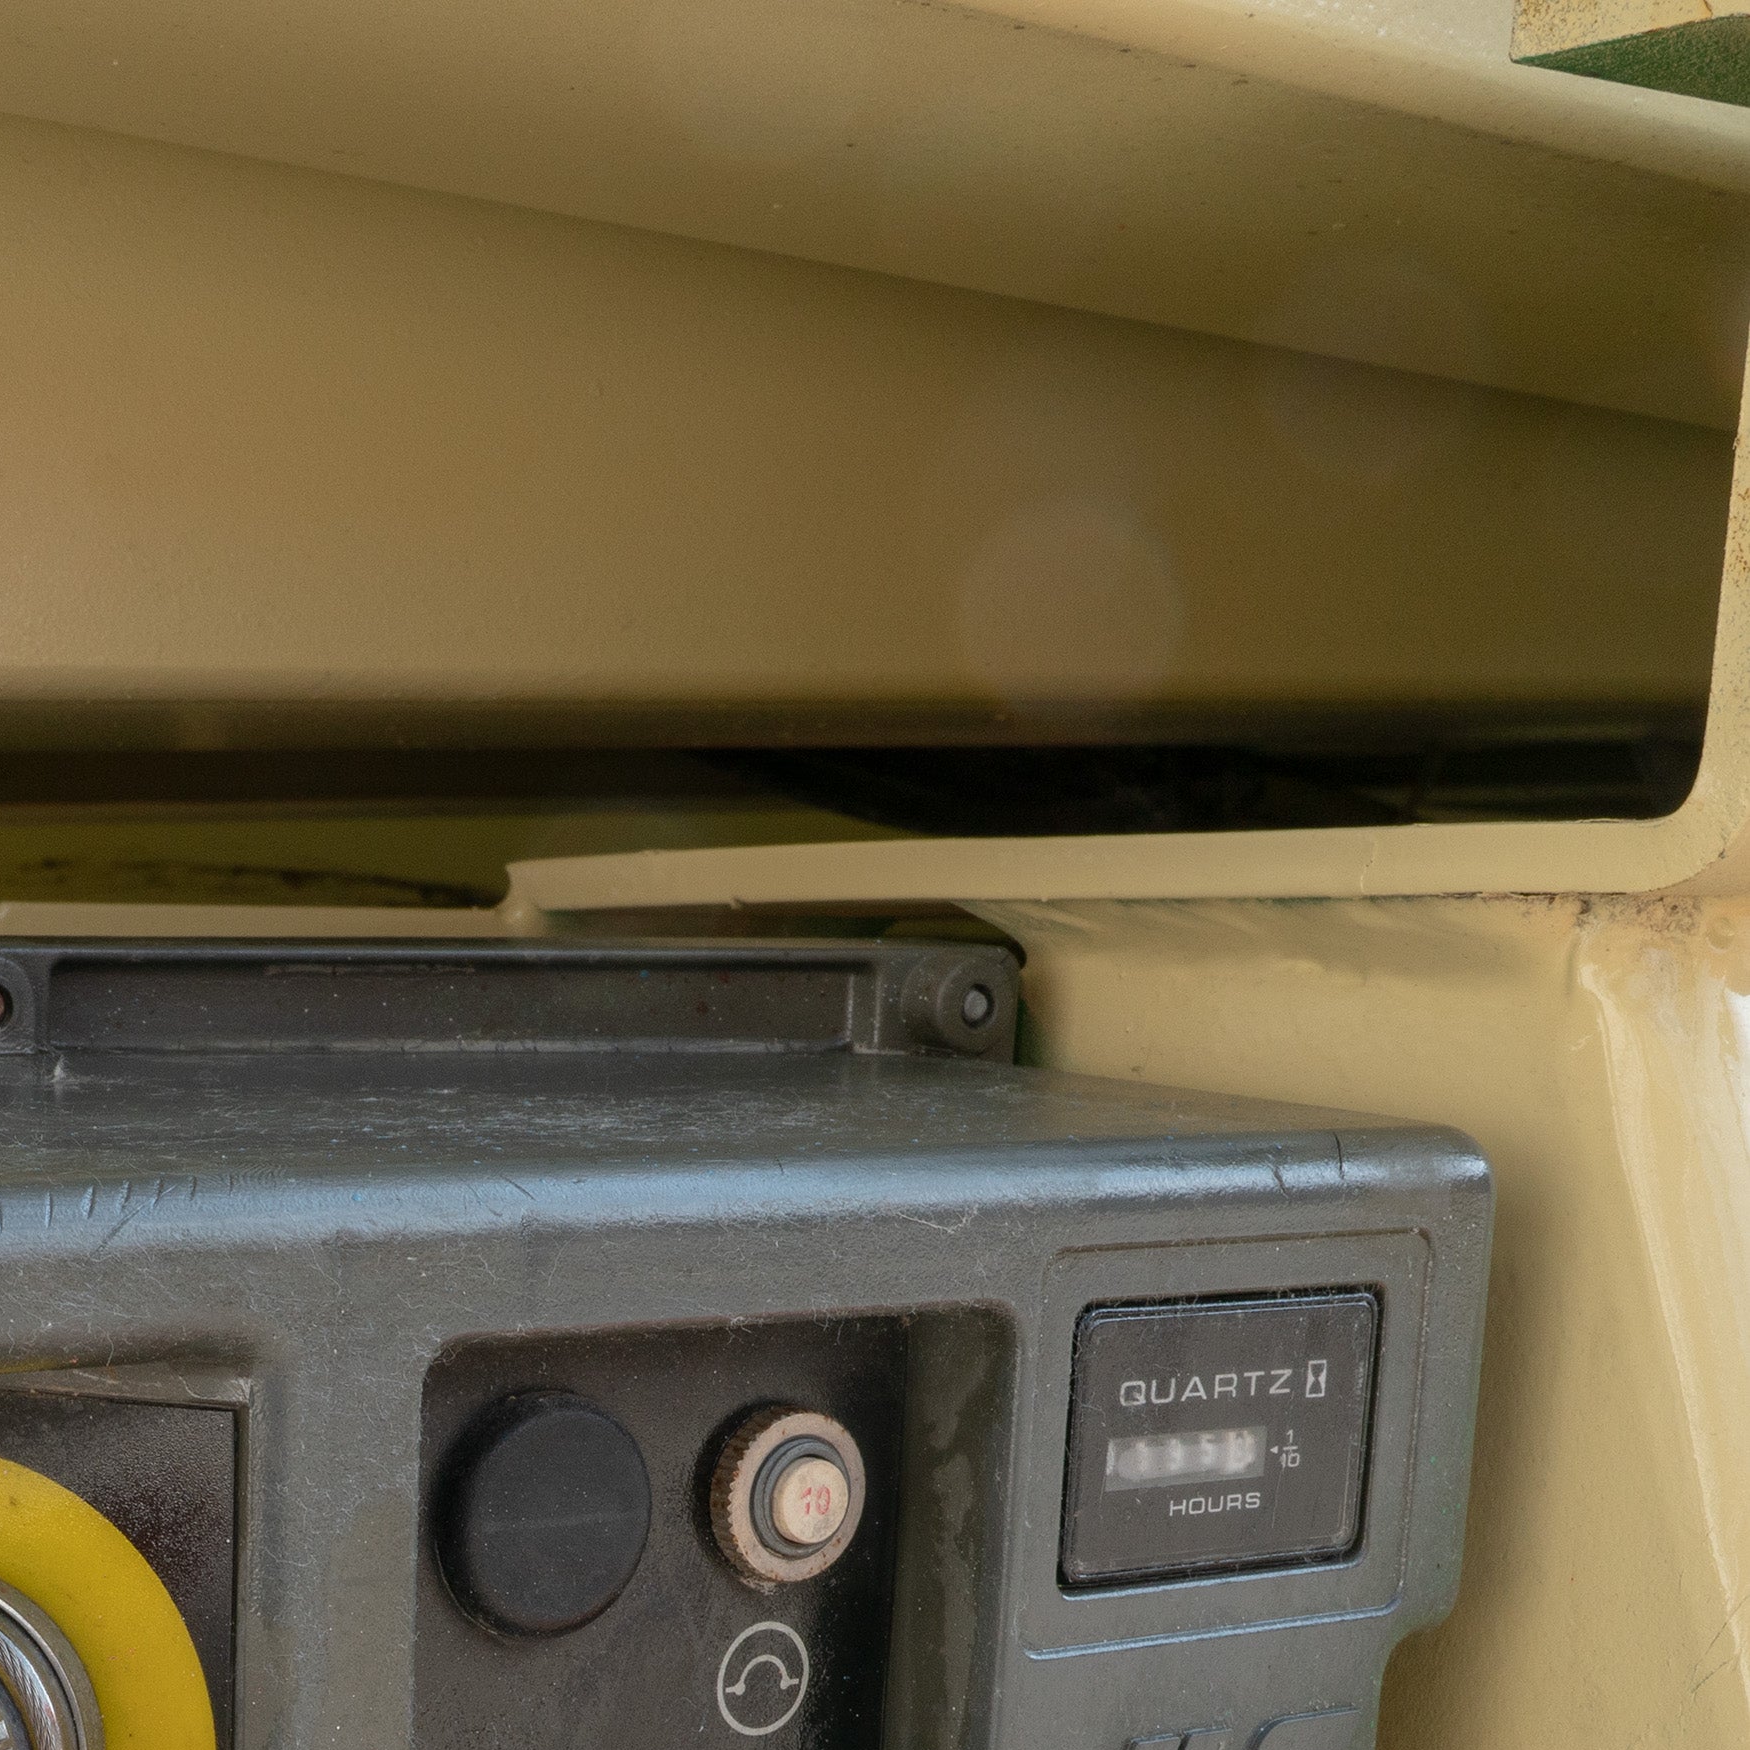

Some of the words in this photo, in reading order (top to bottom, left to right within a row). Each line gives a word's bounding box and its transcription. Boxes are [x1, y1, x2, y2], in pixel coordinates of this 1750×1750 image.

[1118, 1368, 1293, 1407] QUARTZ
[800, 1484, 832, 1517] 10
[1168, 1491, 1261, 1517] HOURS
